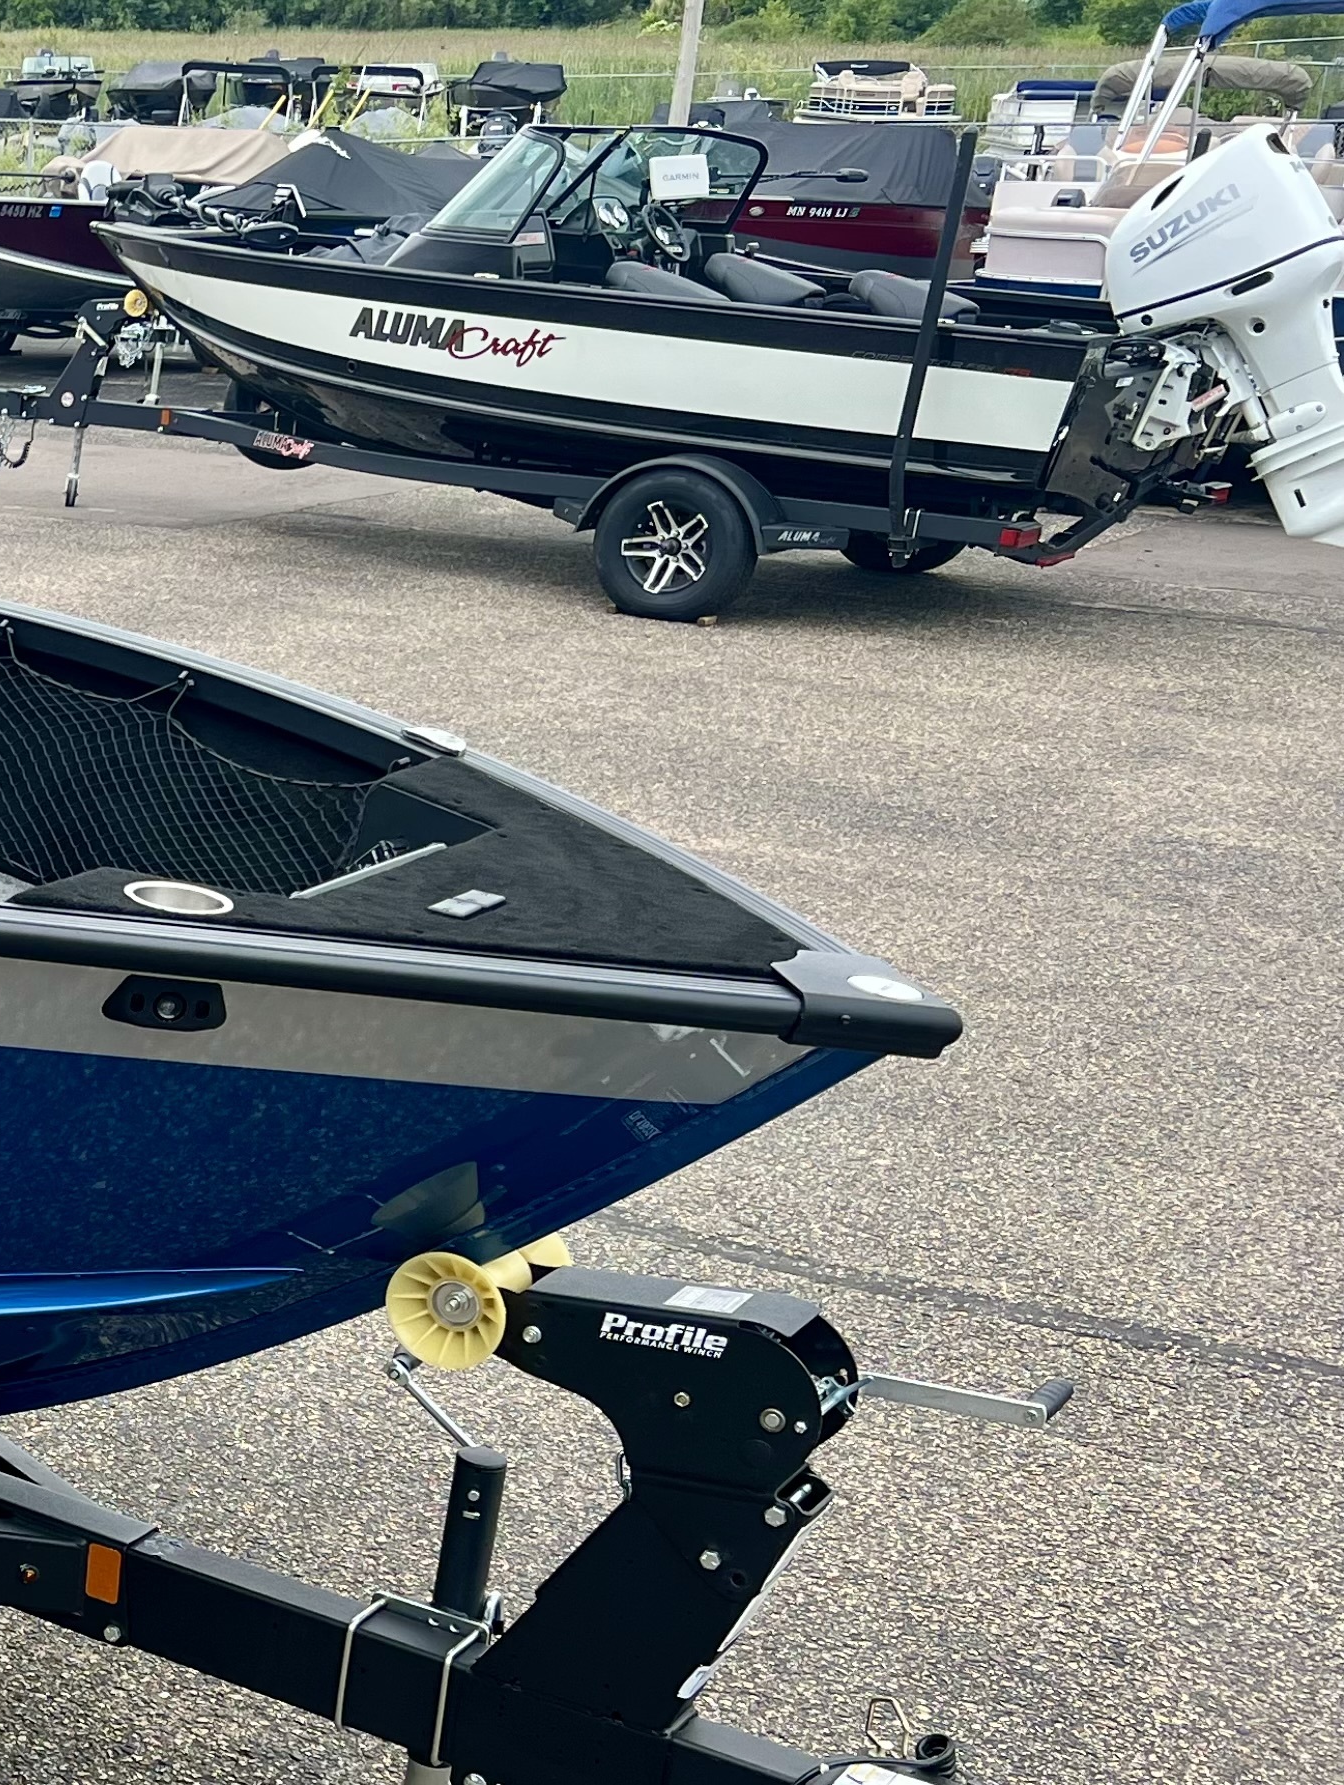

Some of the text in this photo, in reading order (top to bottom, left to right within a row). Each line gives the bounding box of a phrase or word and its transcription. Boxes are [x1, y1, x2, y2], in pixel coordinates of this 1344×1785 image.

[662, 172, 700, 182] GARMIN
[786, 206, 806, 216] MN
[1129, 183, 1242, 263] SUZUKI
[349, 307, 566, 367] ALUMACraft
[599, 1331, 723, 1359] PERFORMANCE WINCH
[600, 1312, 728, 1352] Profile
